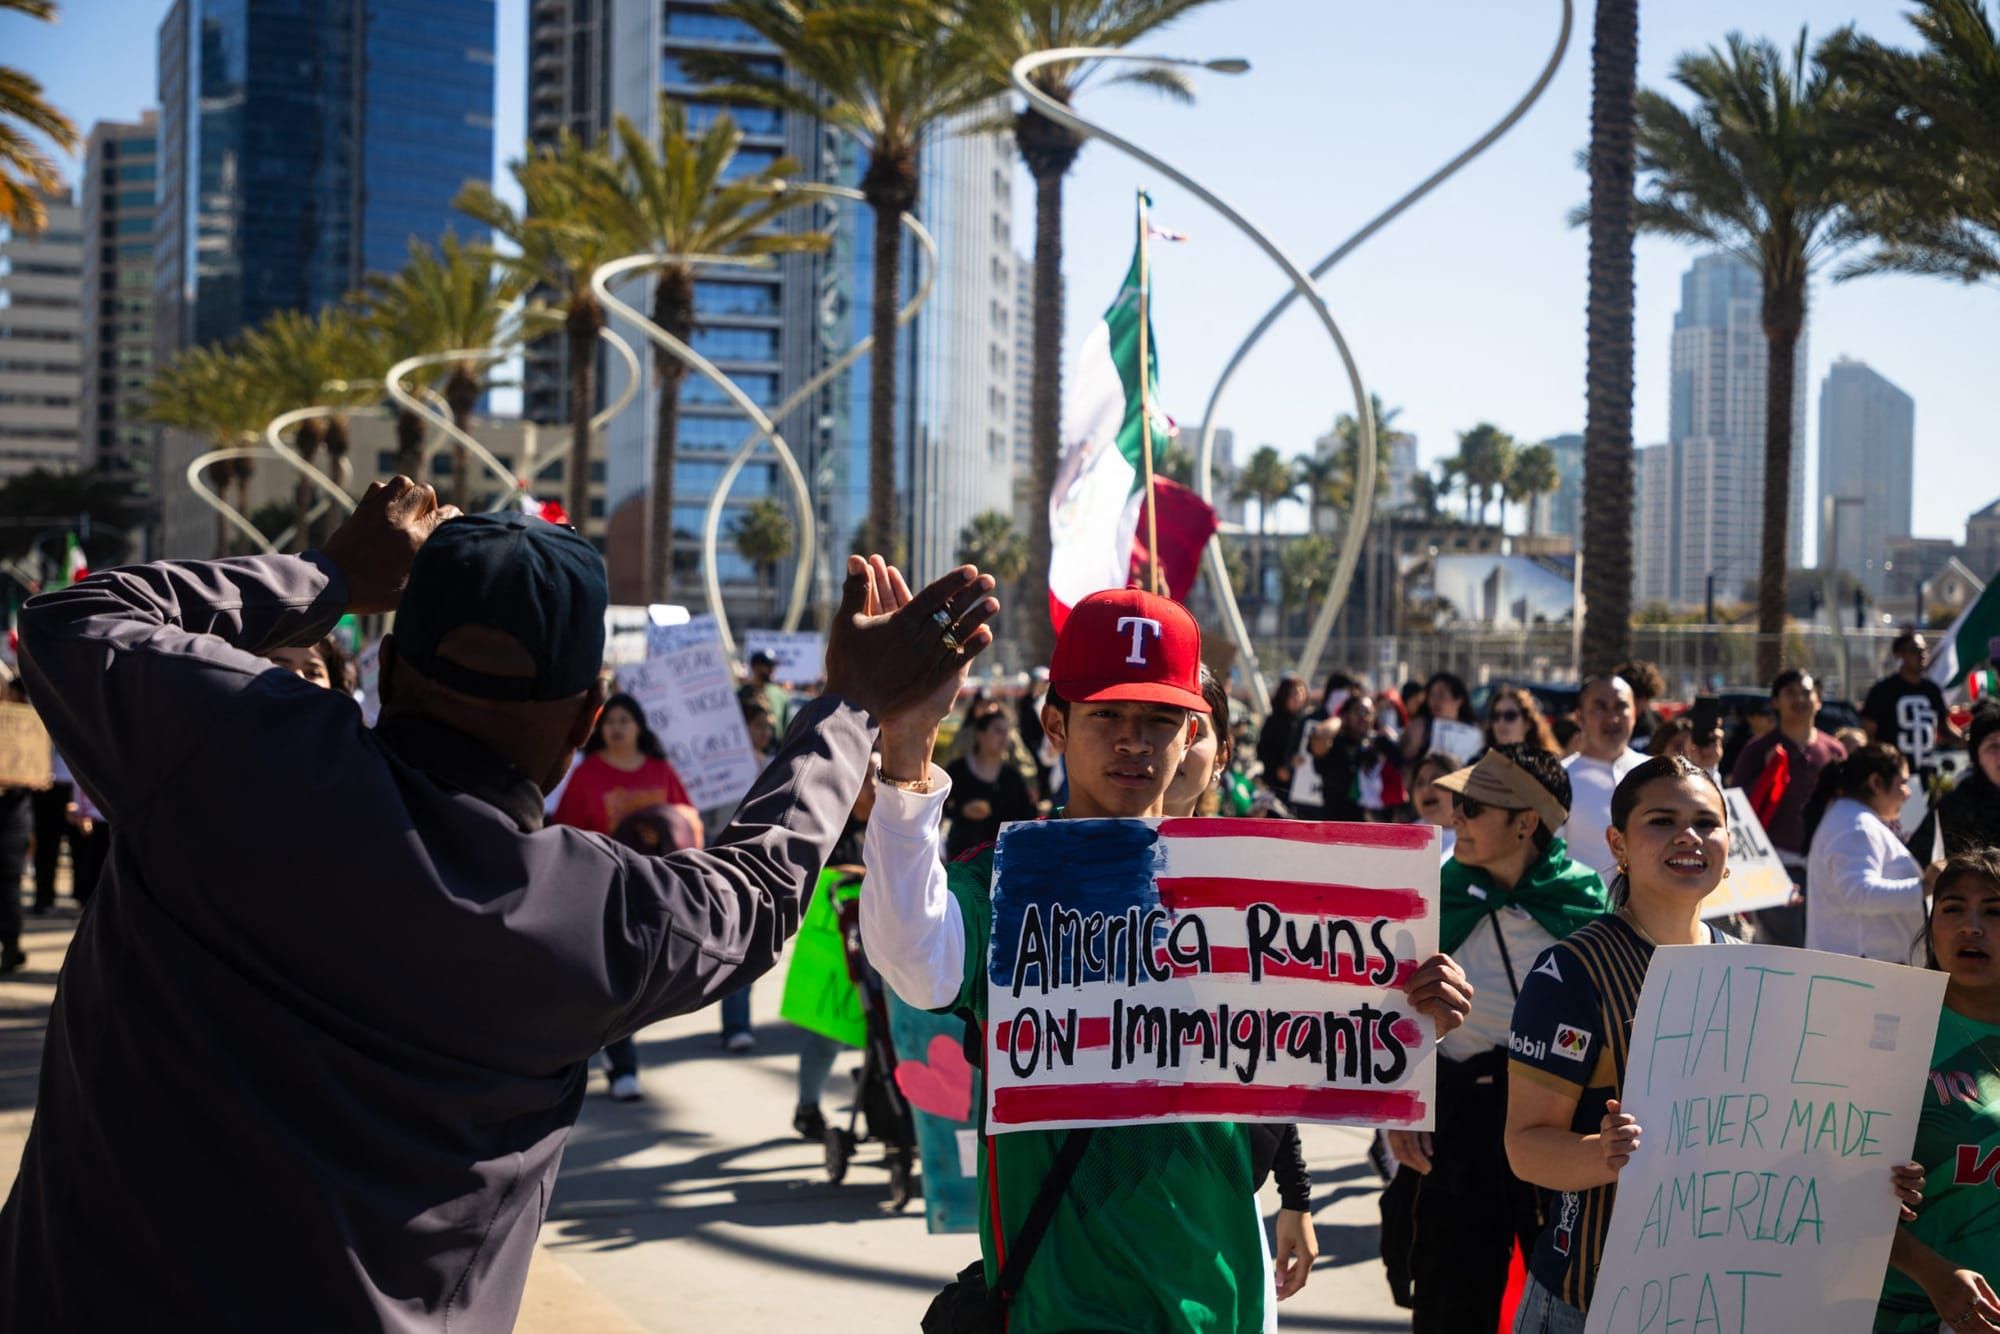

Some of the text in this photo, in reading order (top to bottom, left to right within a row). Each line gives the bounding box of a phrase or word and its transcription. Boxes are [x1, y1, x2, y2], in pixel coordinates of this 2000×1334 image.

[1116, 617, 1161, 667] T
[1247, 904, 1395, 986] Runs
[1011, 1006, 1077, 1080] ON
[1647, 965, 1875, 1096] HATE
[1665, 1094, 1893, 1157] NEVER MADE
[1929, 1071, 1978, 1106] 10
[1635, 1170, 1824, 1254] AMERICA
